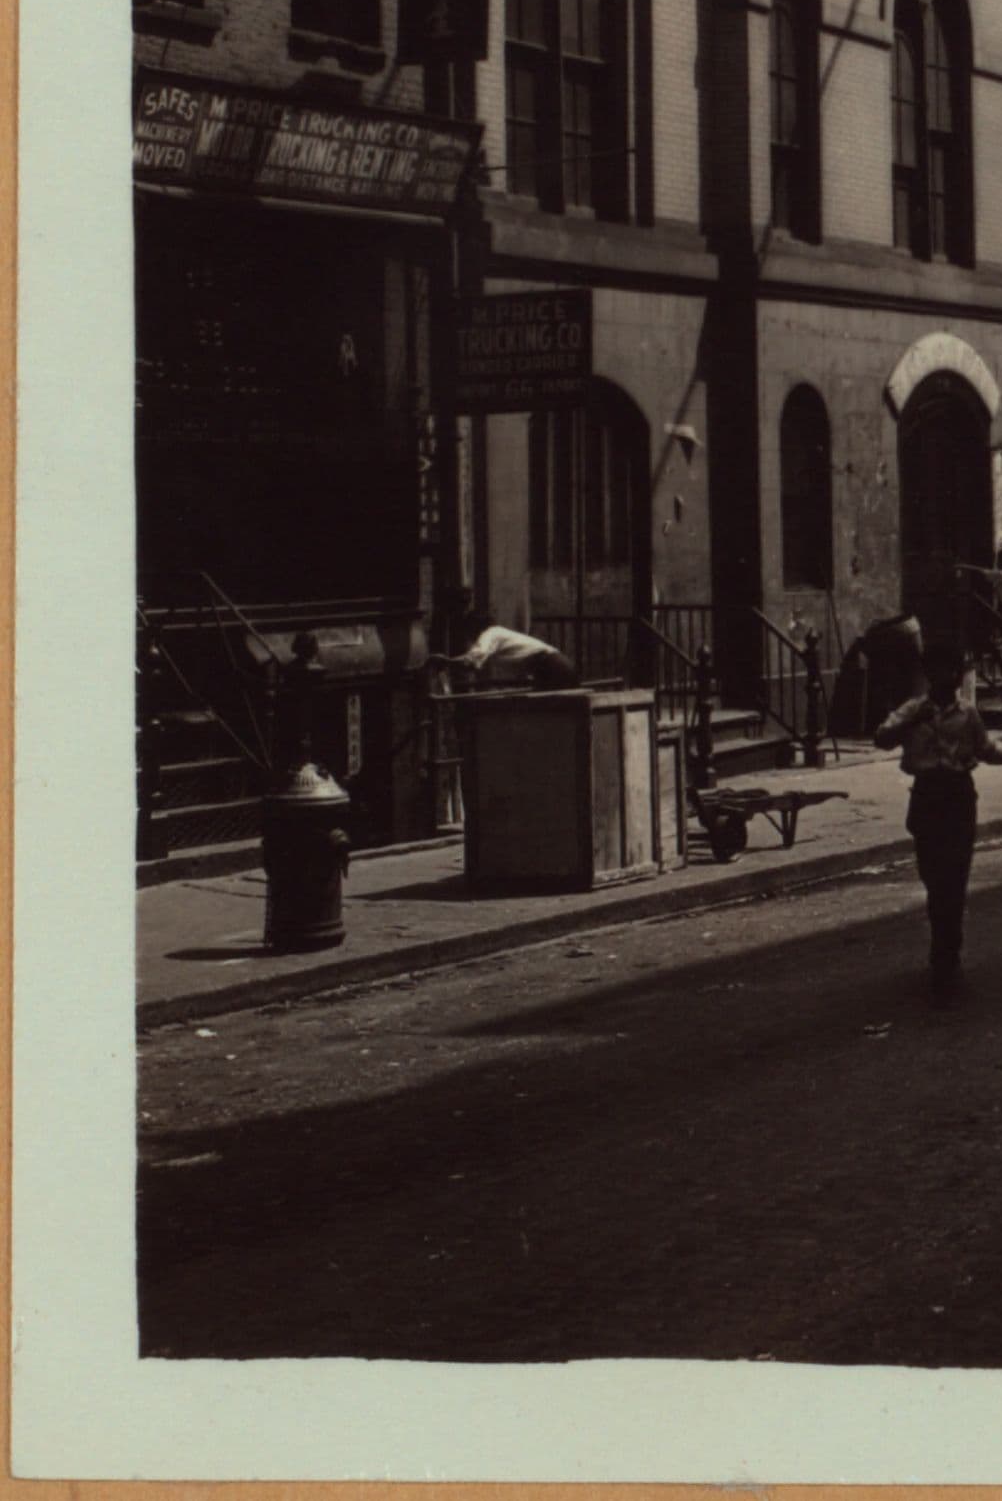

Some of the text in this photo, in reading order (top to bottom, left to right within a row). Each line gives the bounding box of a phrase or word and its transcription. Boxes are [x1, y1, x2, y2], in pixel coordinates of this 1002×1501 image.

[144, 86, 199, 122] SAFES
[232, 97, 291, 131] PRICE
[297, 111, 391, 145] TRUCKING
[135, 139, 186, 169] MOVED
[348, 143, 419, 183] RENTING
[456, 322, 552, 356] TRUCKING
